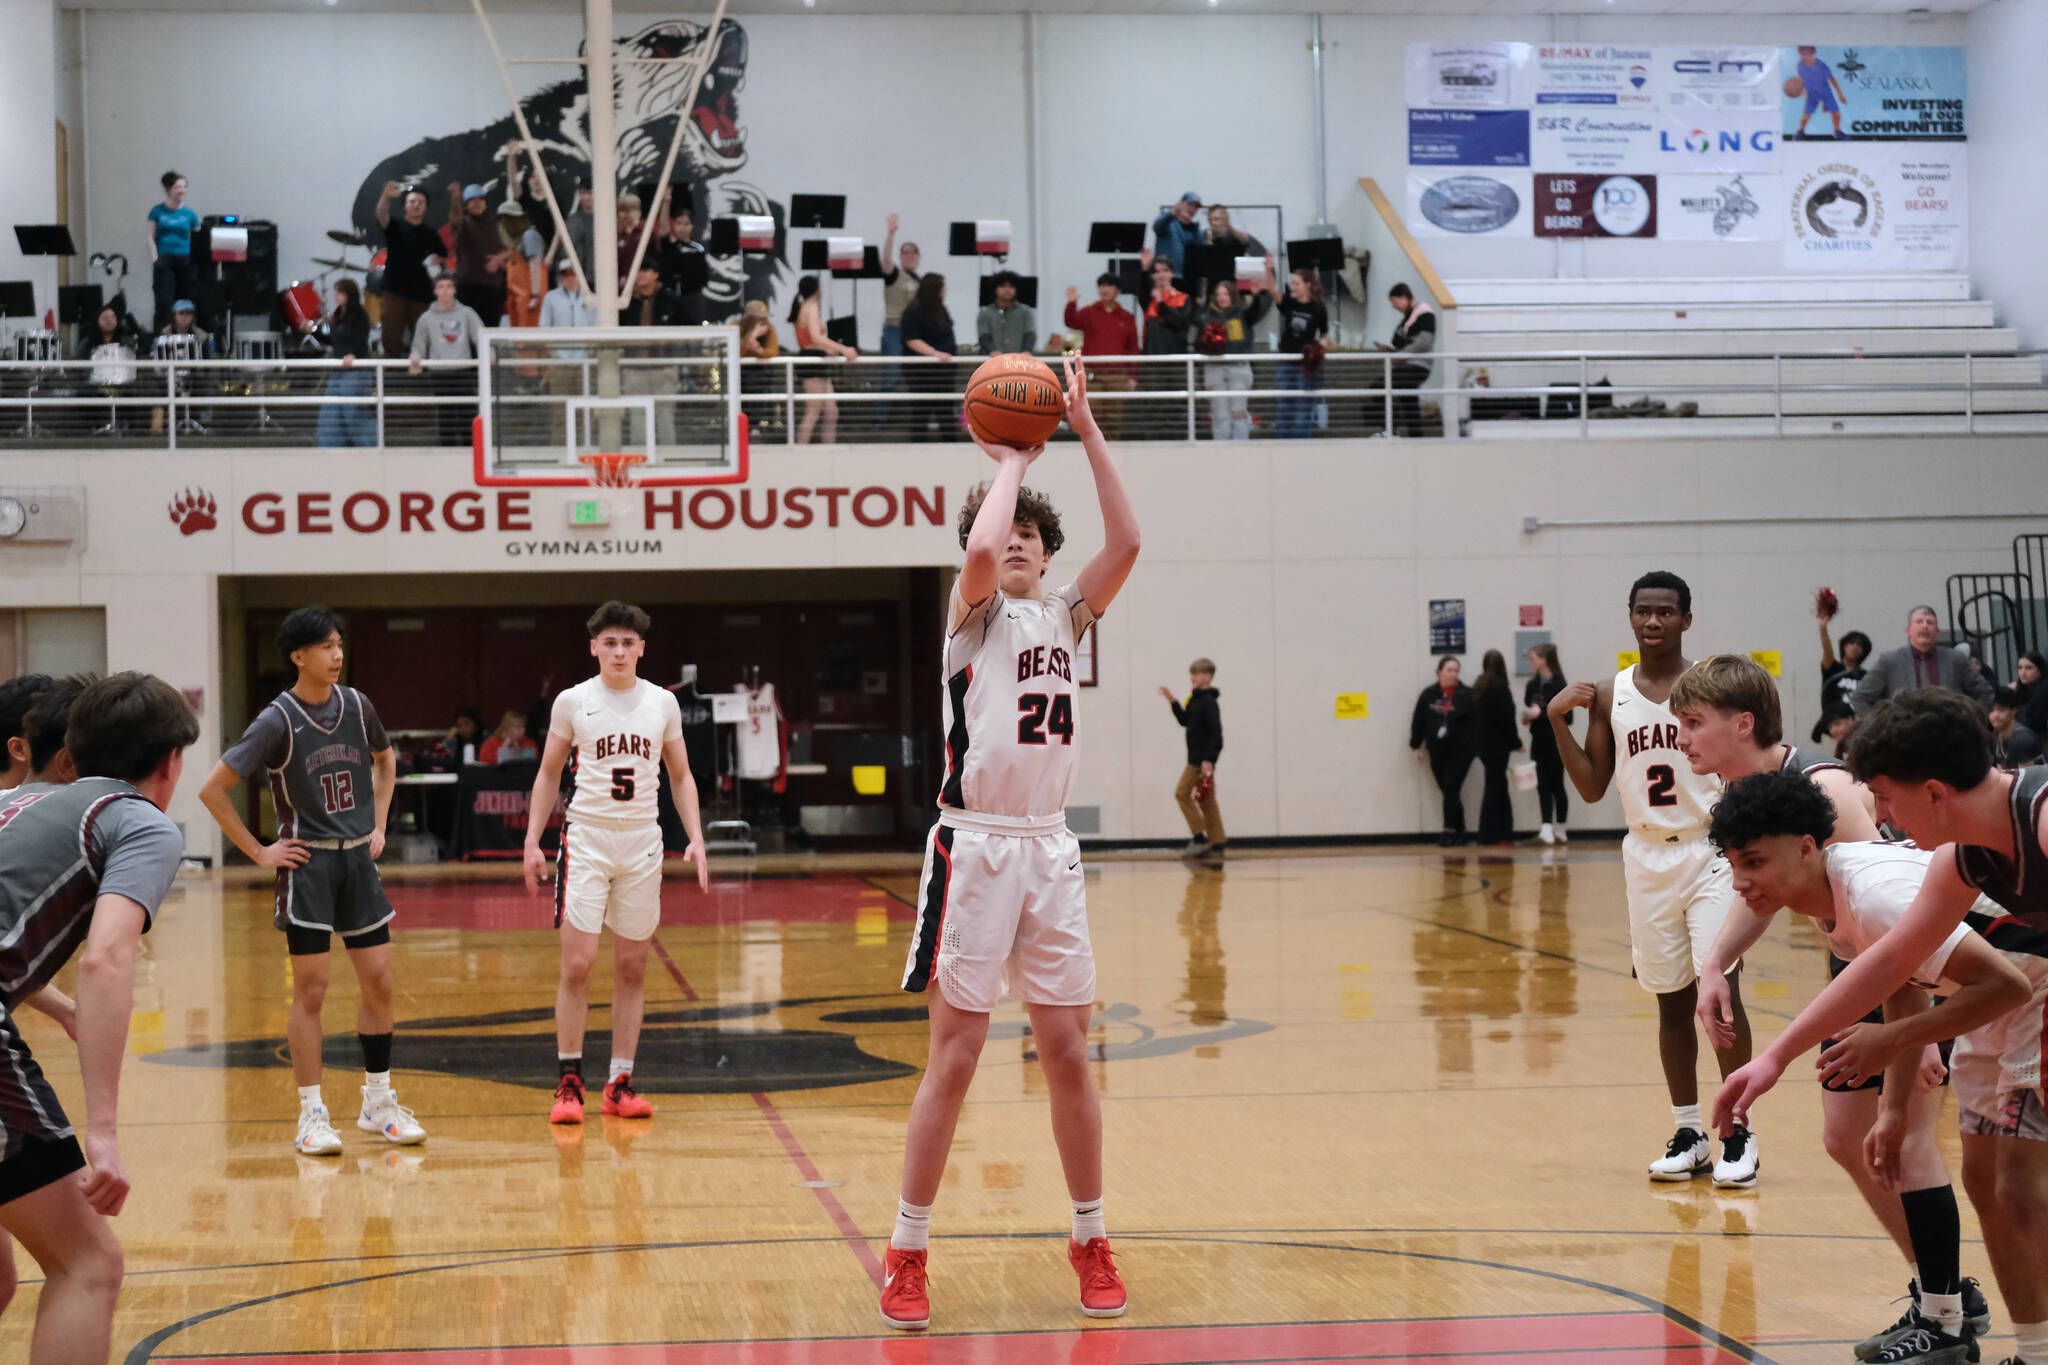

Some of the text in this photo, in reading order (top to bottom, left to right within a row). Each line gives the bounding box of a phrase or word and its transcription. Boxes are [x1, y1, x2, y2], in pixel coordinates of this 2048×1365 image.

[1859, 77, 1934, 91] SEALASKA
[1881, 98, 1963, 110] INVESTING
[1918, 111, 1964, 120] IN OUR
[1851, 121, 1965, 133] COMMUNITIES
[1660, 129, 1774, 152] LONG
[1901, 171, 1951, 181] Welcome!
[1550, 179, 1577, 194] LETS
[1917, 185, 1936, 198] GO
[1791, 173, 1815, 239] FRATERNAL
[1817, 163, 1859, 177] ORDER
[1860, 174, 1875, 189] OF
[1904, 199, 1949, 212] BEARS!
[1543, 215, 1584, 230] BEARS!
[1804, 239, 1873, 250] CHARITIES
[990, 381, 1059, 407] THE ROCK
[242, 485, 946, 535] GEORGE HOUSTON
[505, 539, 663, 556] GYMNASIUM
[1017, 692, 1074, 746] 24
[596, 732, 652, 761] BEARS
[1627, 723, 1685, 758] BEAR
[320, 769, 356, 815] 12
[610, 767, 636, 802] 5
[1646, 763, 1678, 808] 2
